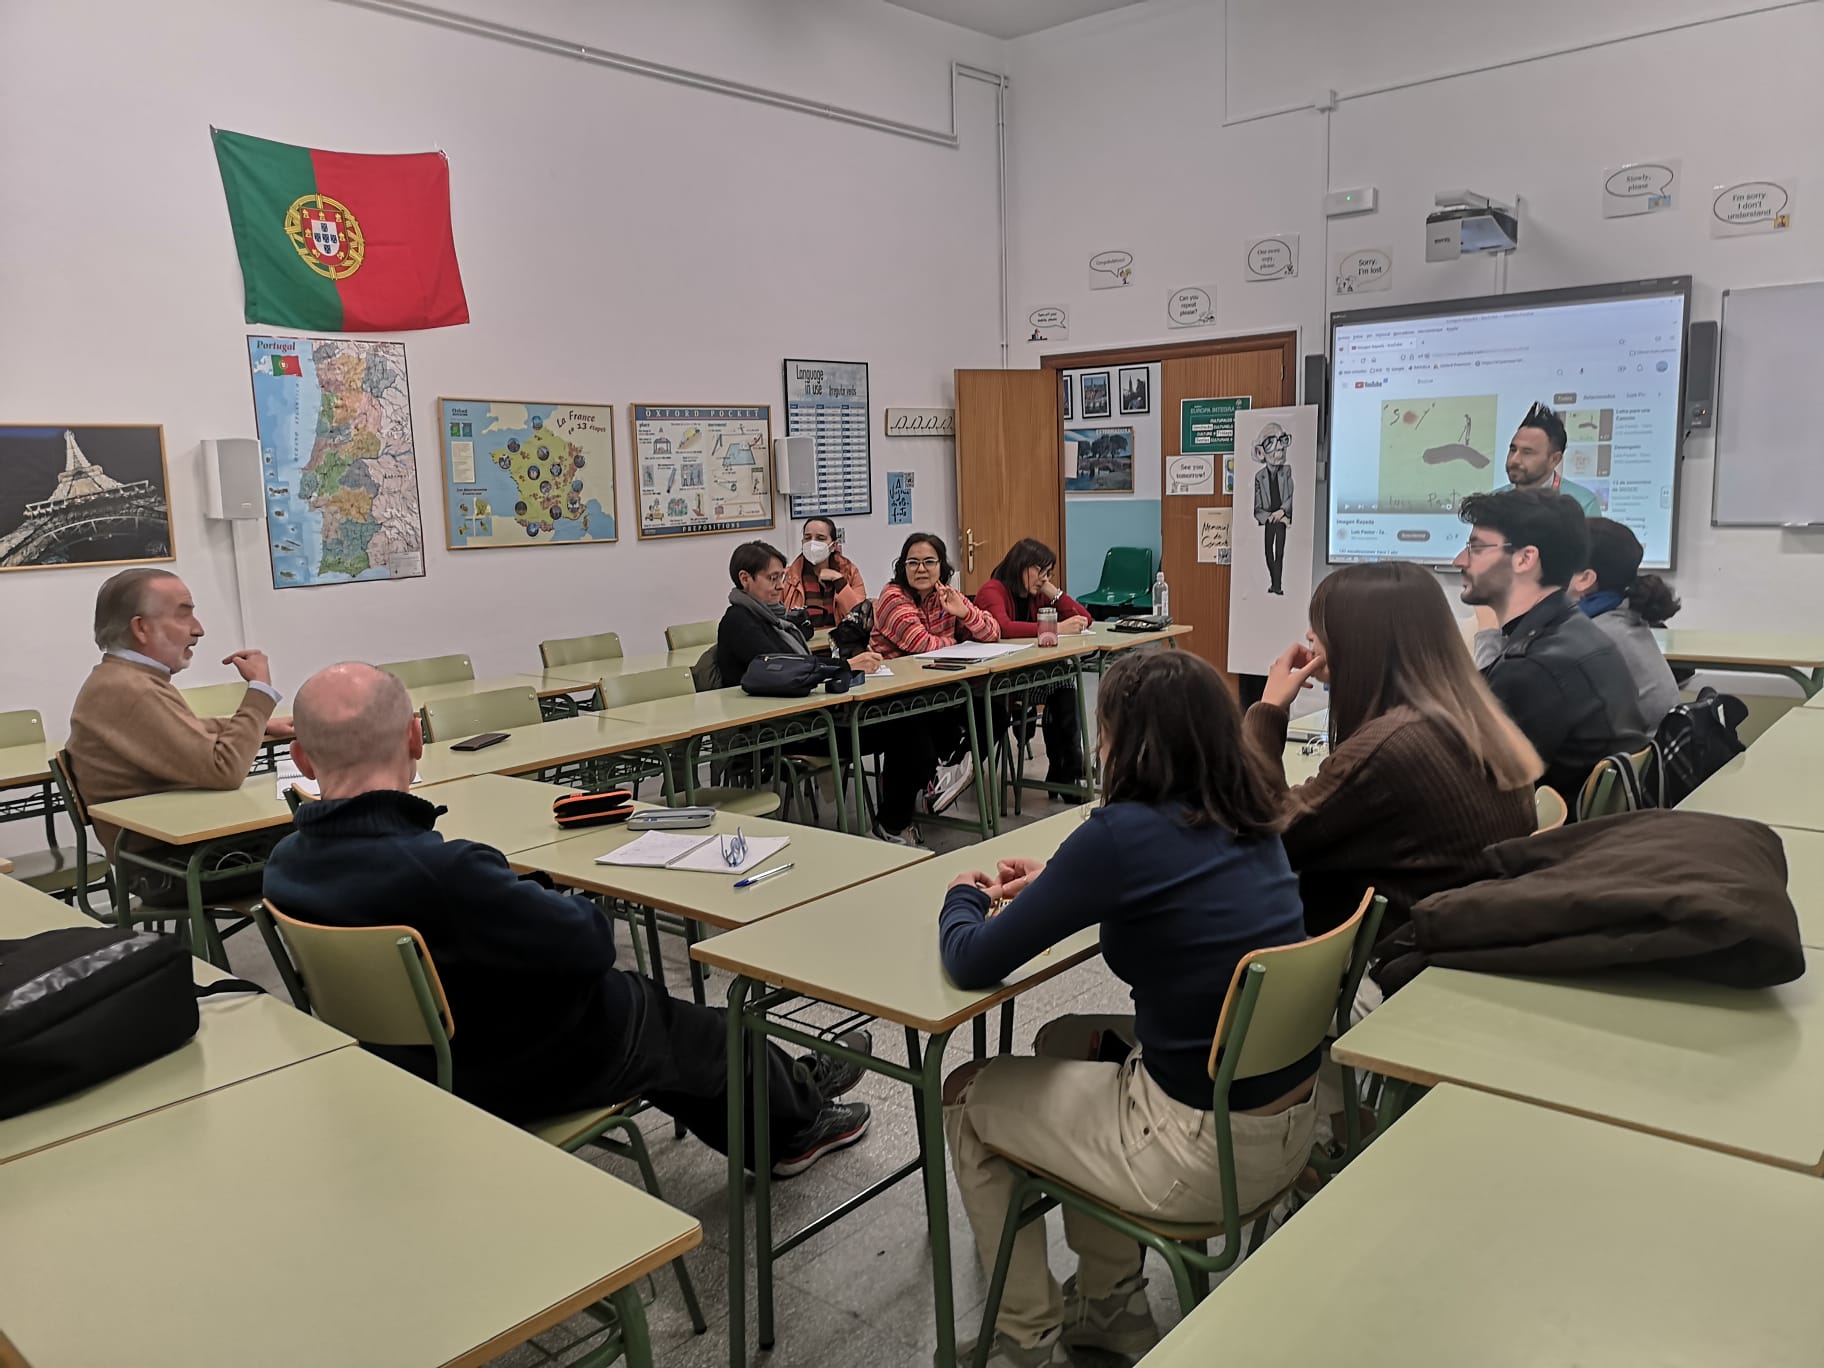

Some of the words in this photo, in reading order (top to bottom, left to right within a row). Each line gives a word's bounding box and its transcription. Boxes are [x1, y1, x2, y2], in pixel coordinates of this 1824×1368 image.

[1732, 194, 1745, 202] I'm
[1727, 208, 1772, 221] understand
[1358, 268, 1369, 276] I'm
[256, 340, 296, 352] Portugal
[795, 364, 824, 384] Language
[804, 383, 811, 396] in
[812, 383, 823, 396] use
[645, 409, 700, 417] OXFORD
[710, 409, 760, 417] POCKET
[556, 417, 566, 428] La
[569, 410, 596, 423] France
[577, 422, 587, 430] 13
[1180, 463, 1192, 471] See
[1192, 464, 1204, 472] you
[1176, 471, 1206, 480] tomorrow!
[682, 522, 741, 533] PREPOSITIONS
